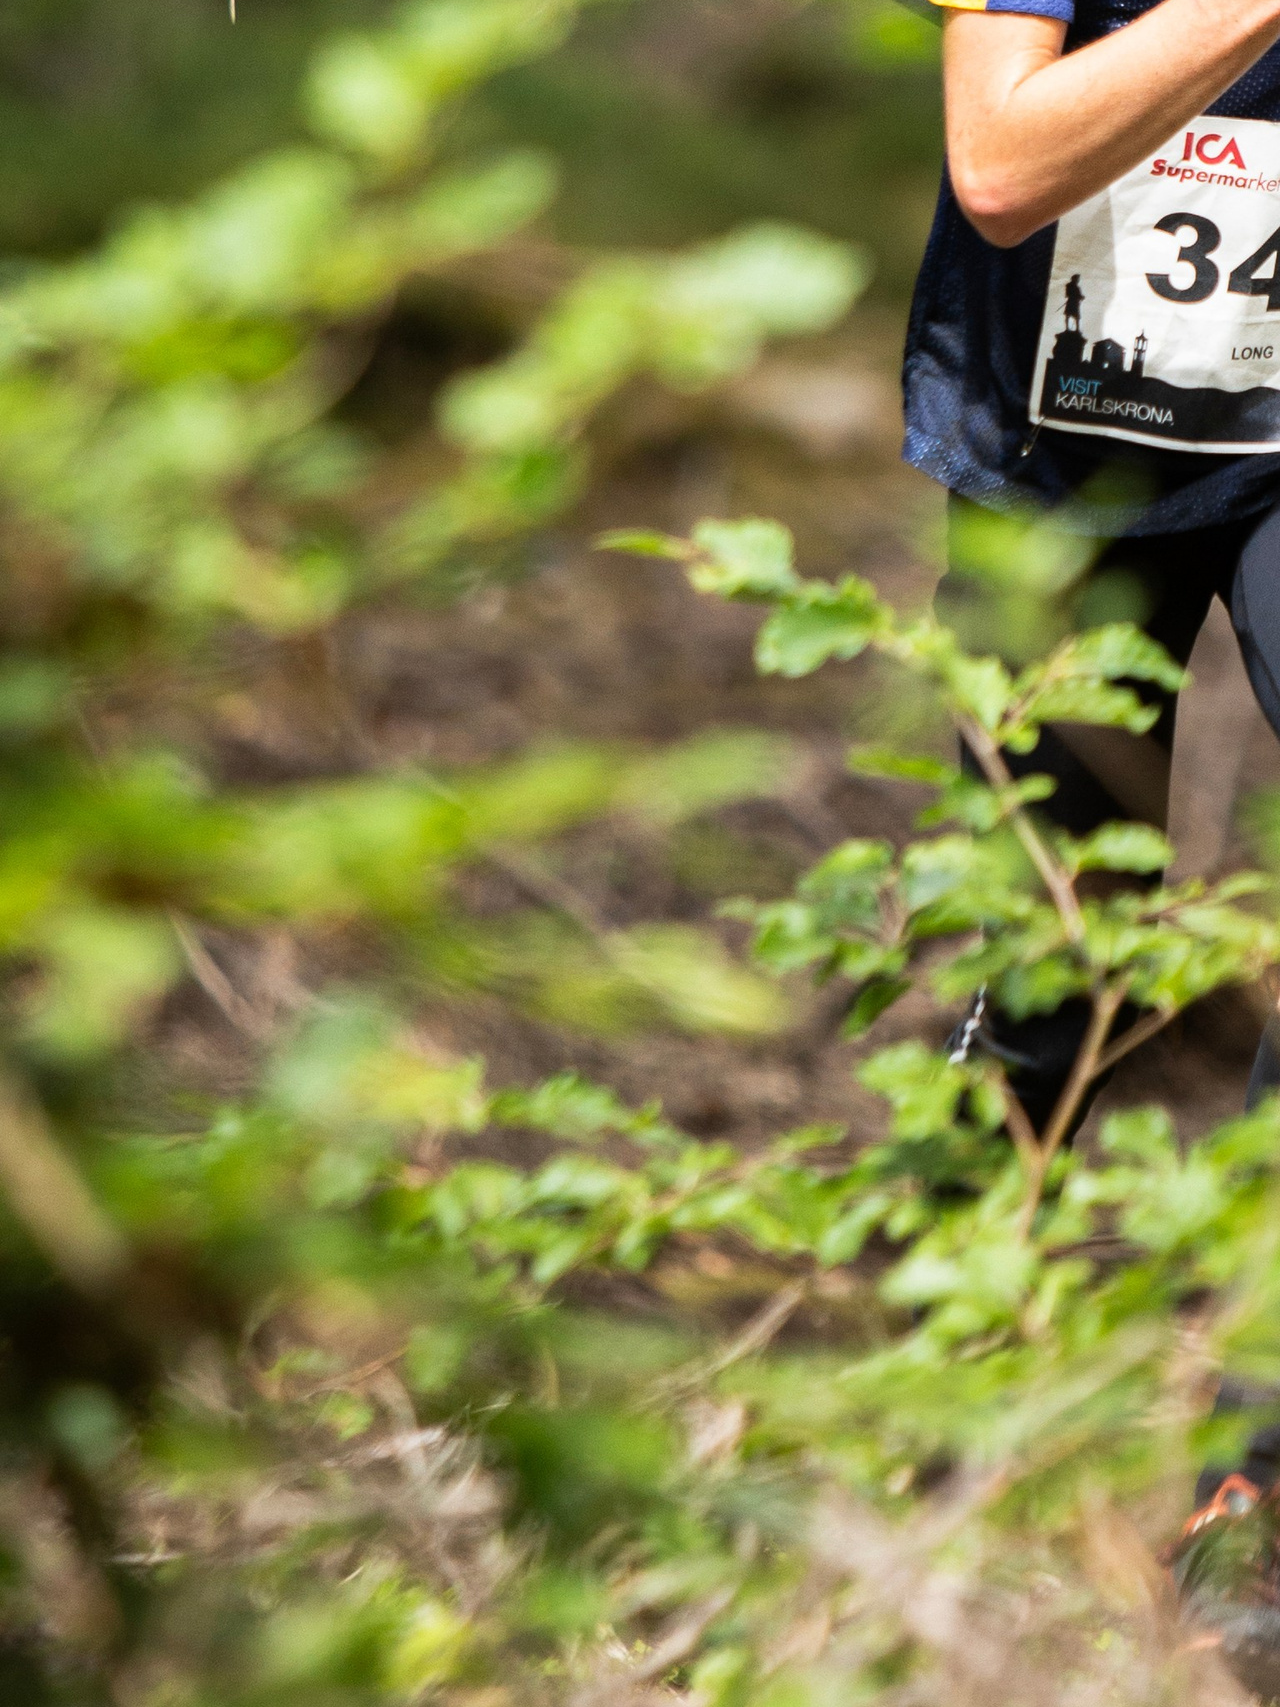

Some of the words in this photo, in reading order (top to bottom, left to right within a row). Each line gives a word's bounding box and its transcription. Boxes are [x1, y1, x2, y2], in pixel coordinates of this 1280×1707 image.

[1182, 131, 1247, 170] ICA
[1231, 345, 1275, 362] LONG
[1059, 375, 1103, 396] VISIT
